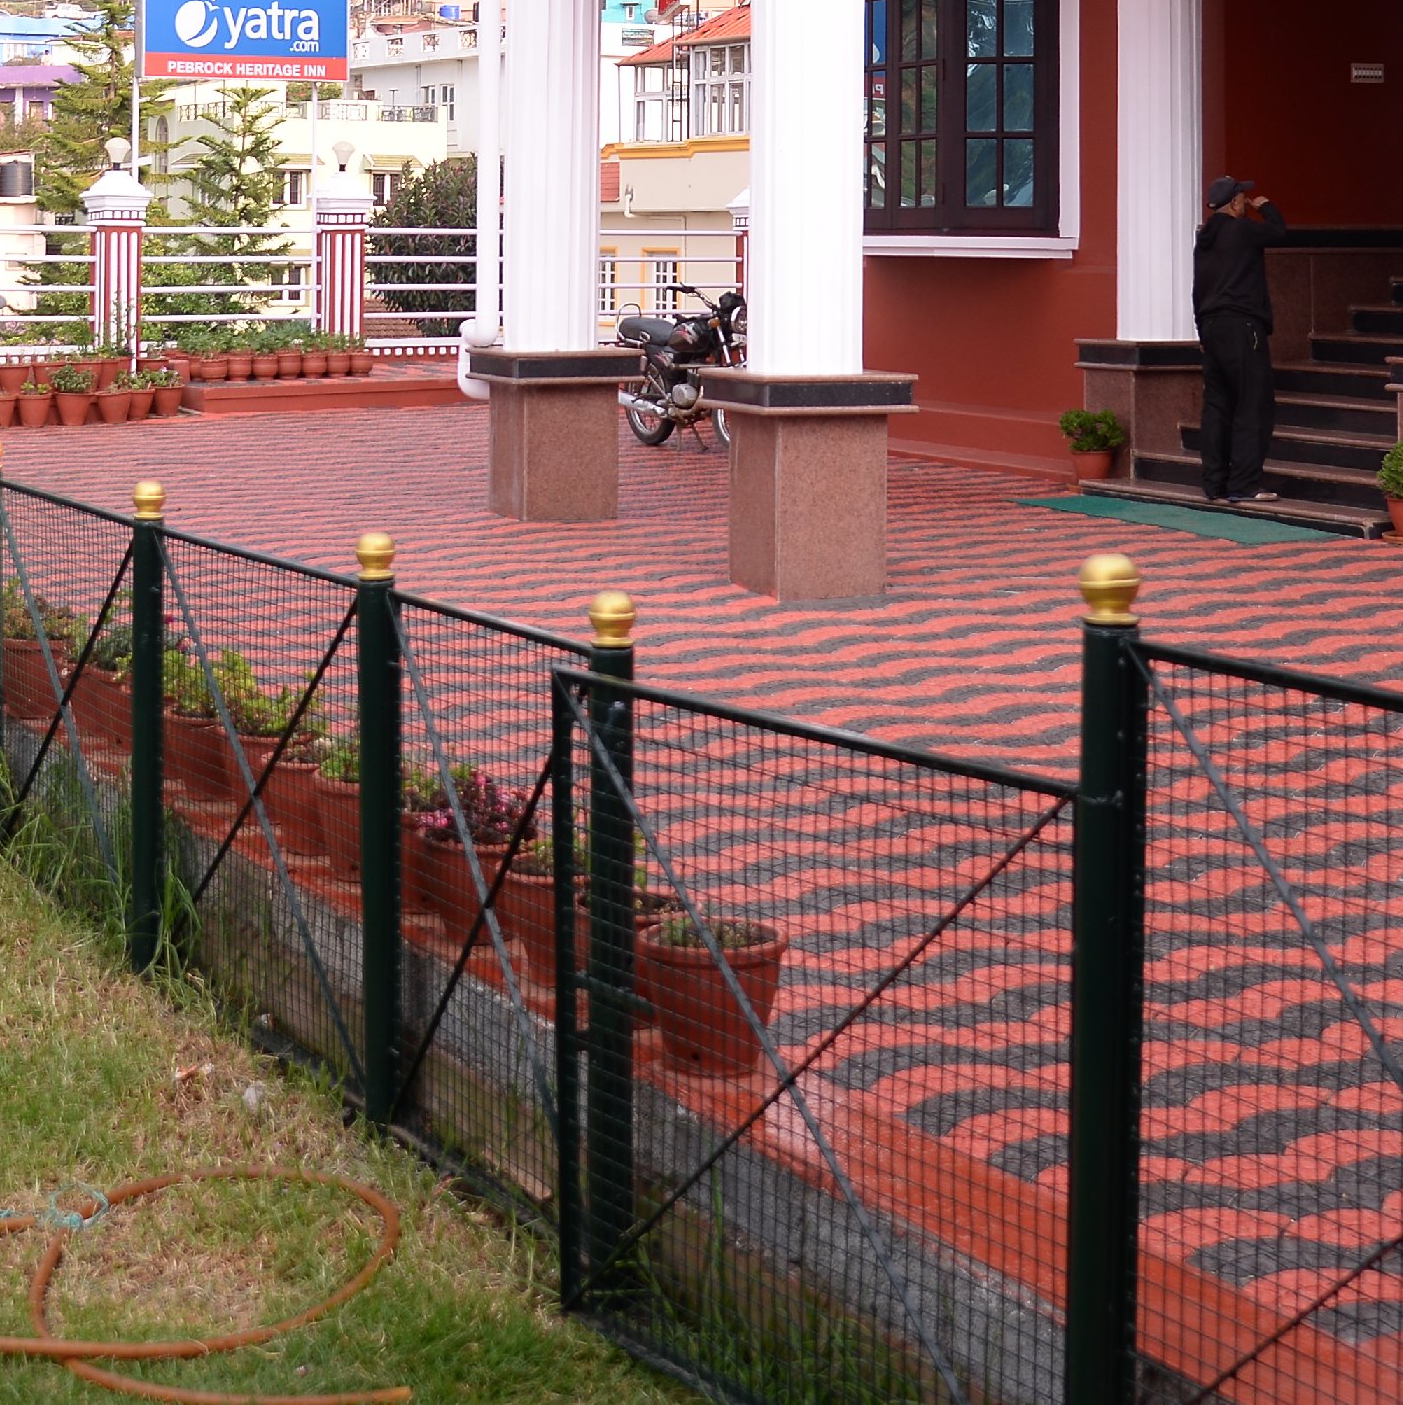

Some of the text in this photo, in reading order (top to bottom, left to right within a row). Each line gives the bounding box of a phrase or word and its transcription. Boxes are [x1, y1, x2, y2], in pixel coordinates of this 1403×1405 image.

[222, 1, 319, 50] yatra
[289, 39, 319, 52] .com
[167, 60, 326, 77] PEBROCK HERITAGE INN
